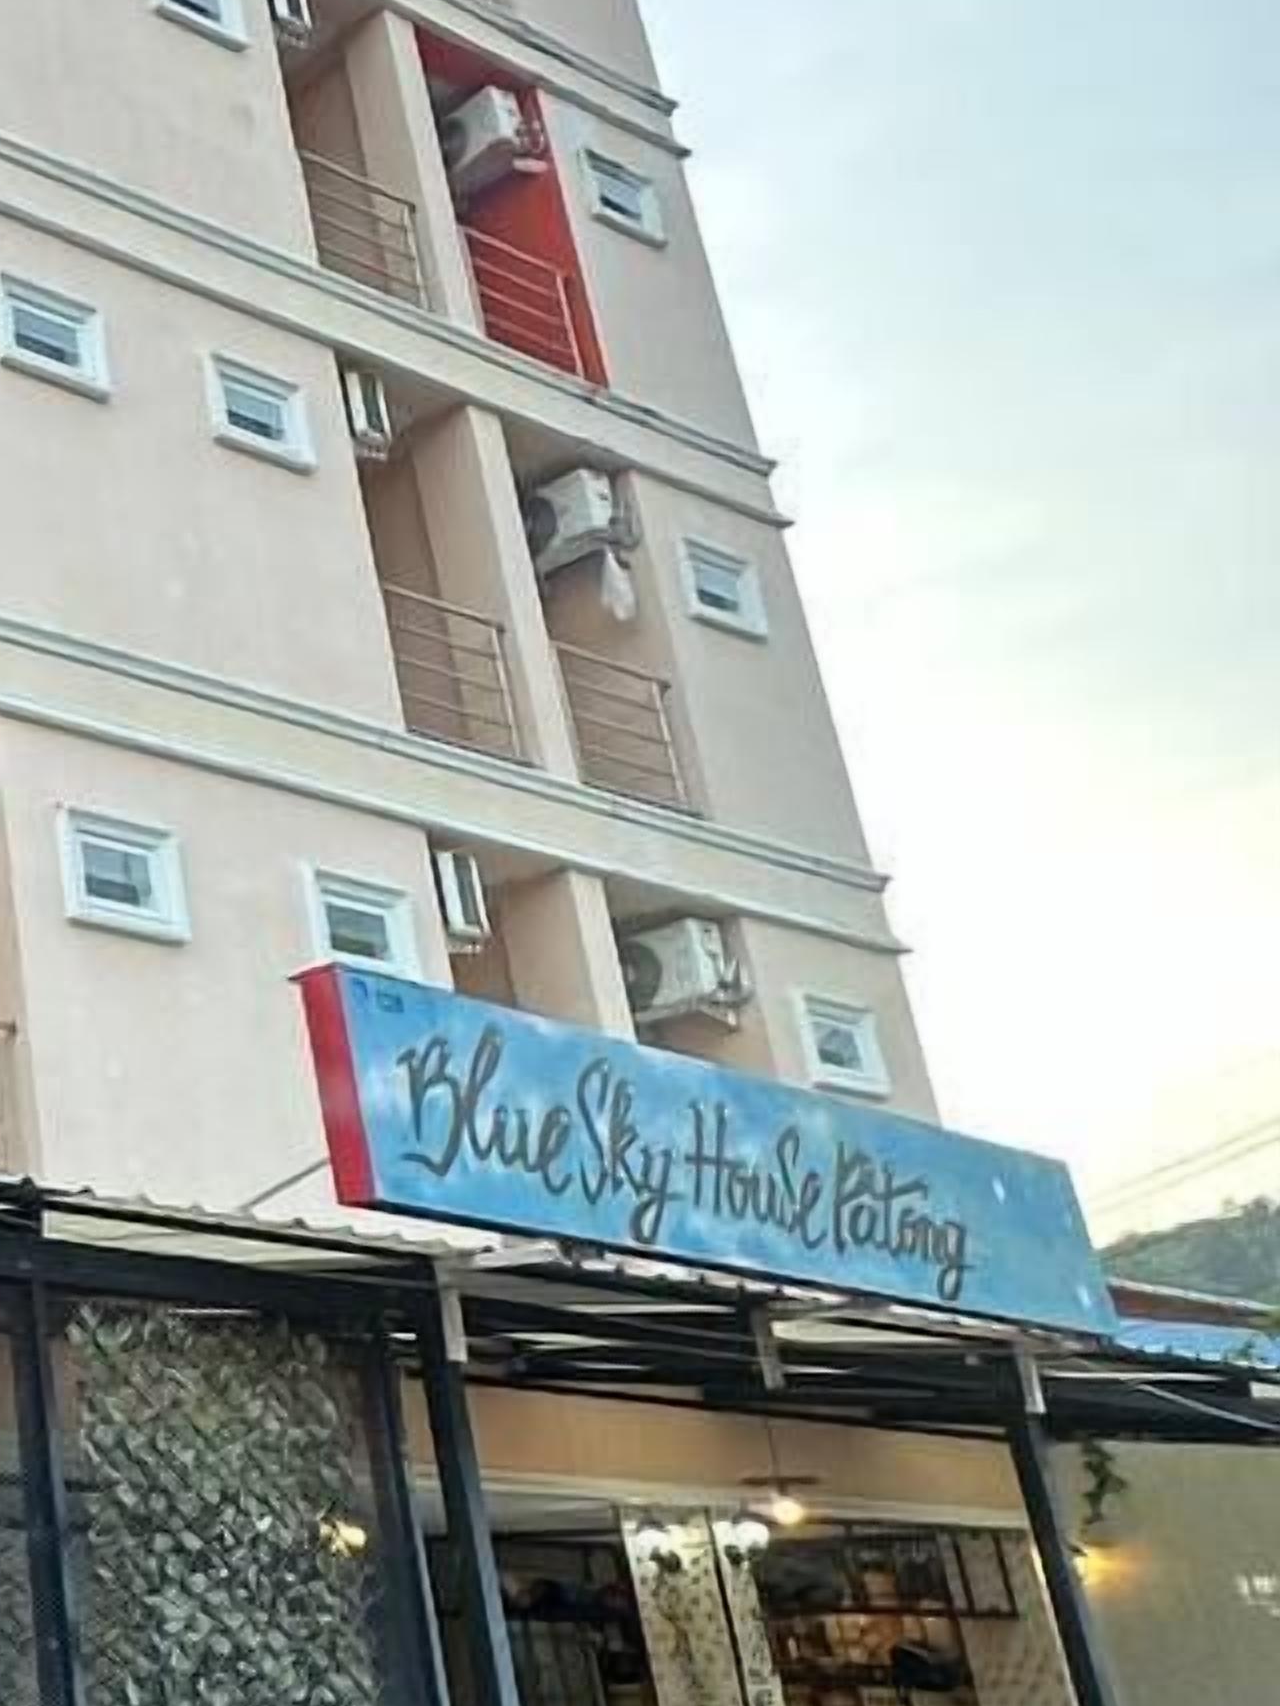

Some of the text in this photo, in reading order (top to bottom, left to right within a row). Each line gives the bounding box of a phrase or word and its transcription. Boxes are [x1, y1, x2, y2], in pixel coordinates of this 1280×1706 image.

[396, 1023, 573, 1194] Blue
[576, 1056, 685, 1246] Sky
[833, 1141, 977, 1301] Patong
